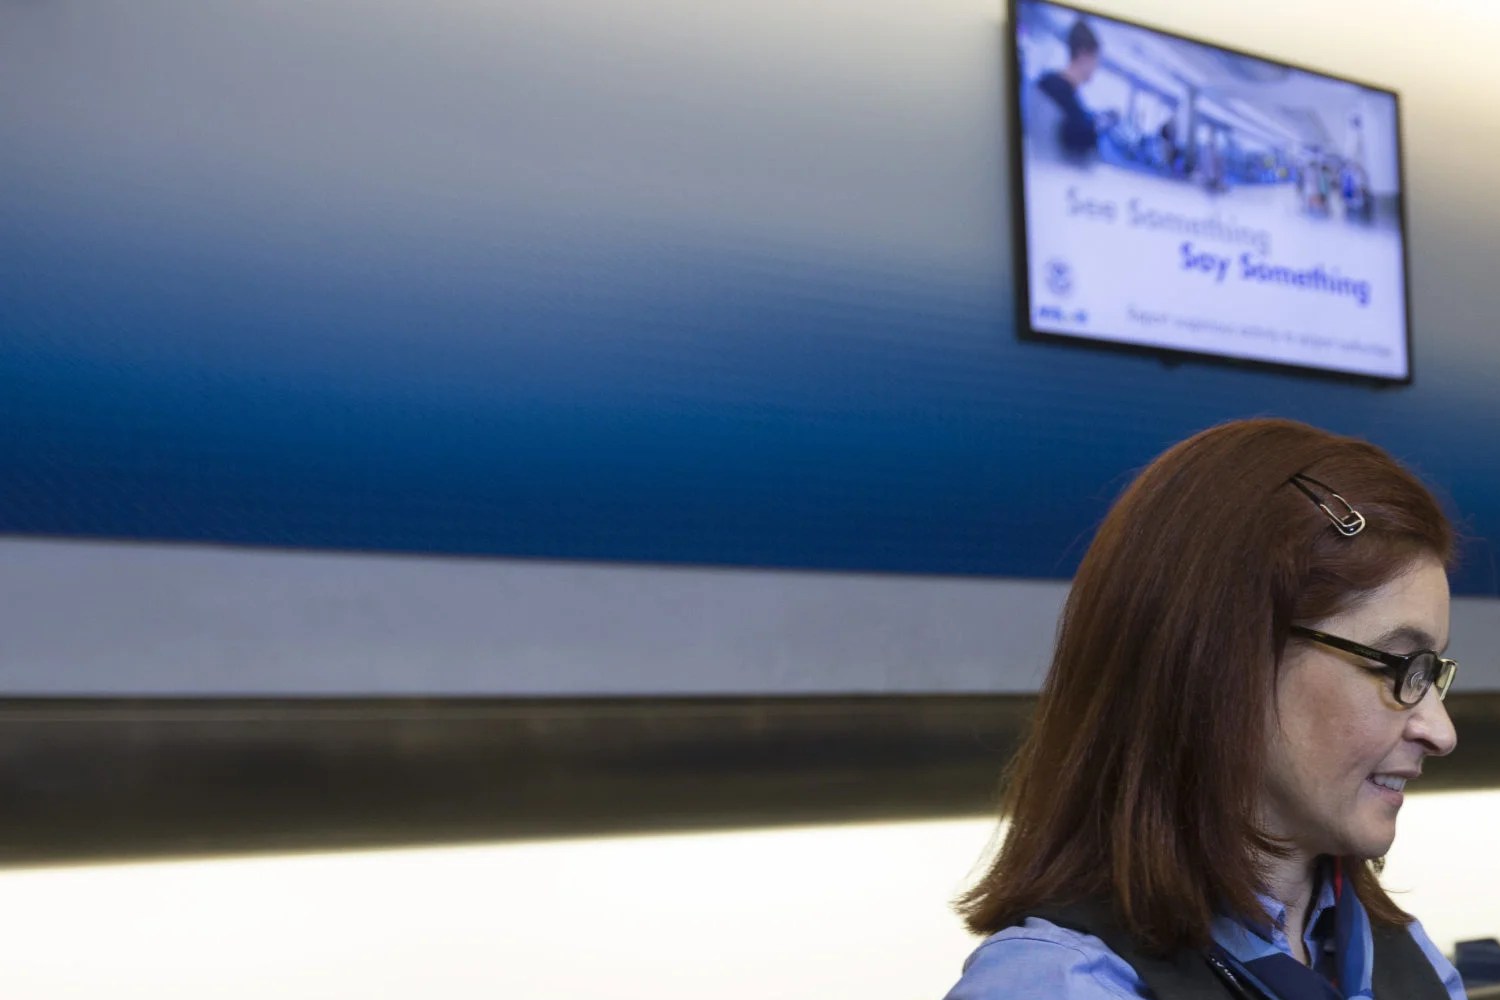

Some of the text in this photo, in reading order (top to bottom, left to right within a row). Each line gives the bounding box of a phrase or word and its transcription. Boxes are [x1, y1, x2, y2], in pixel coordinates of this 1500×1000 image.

[1066, 186, 1271, 255] See Something
[1180, 242, 1371, 306] Say Something
